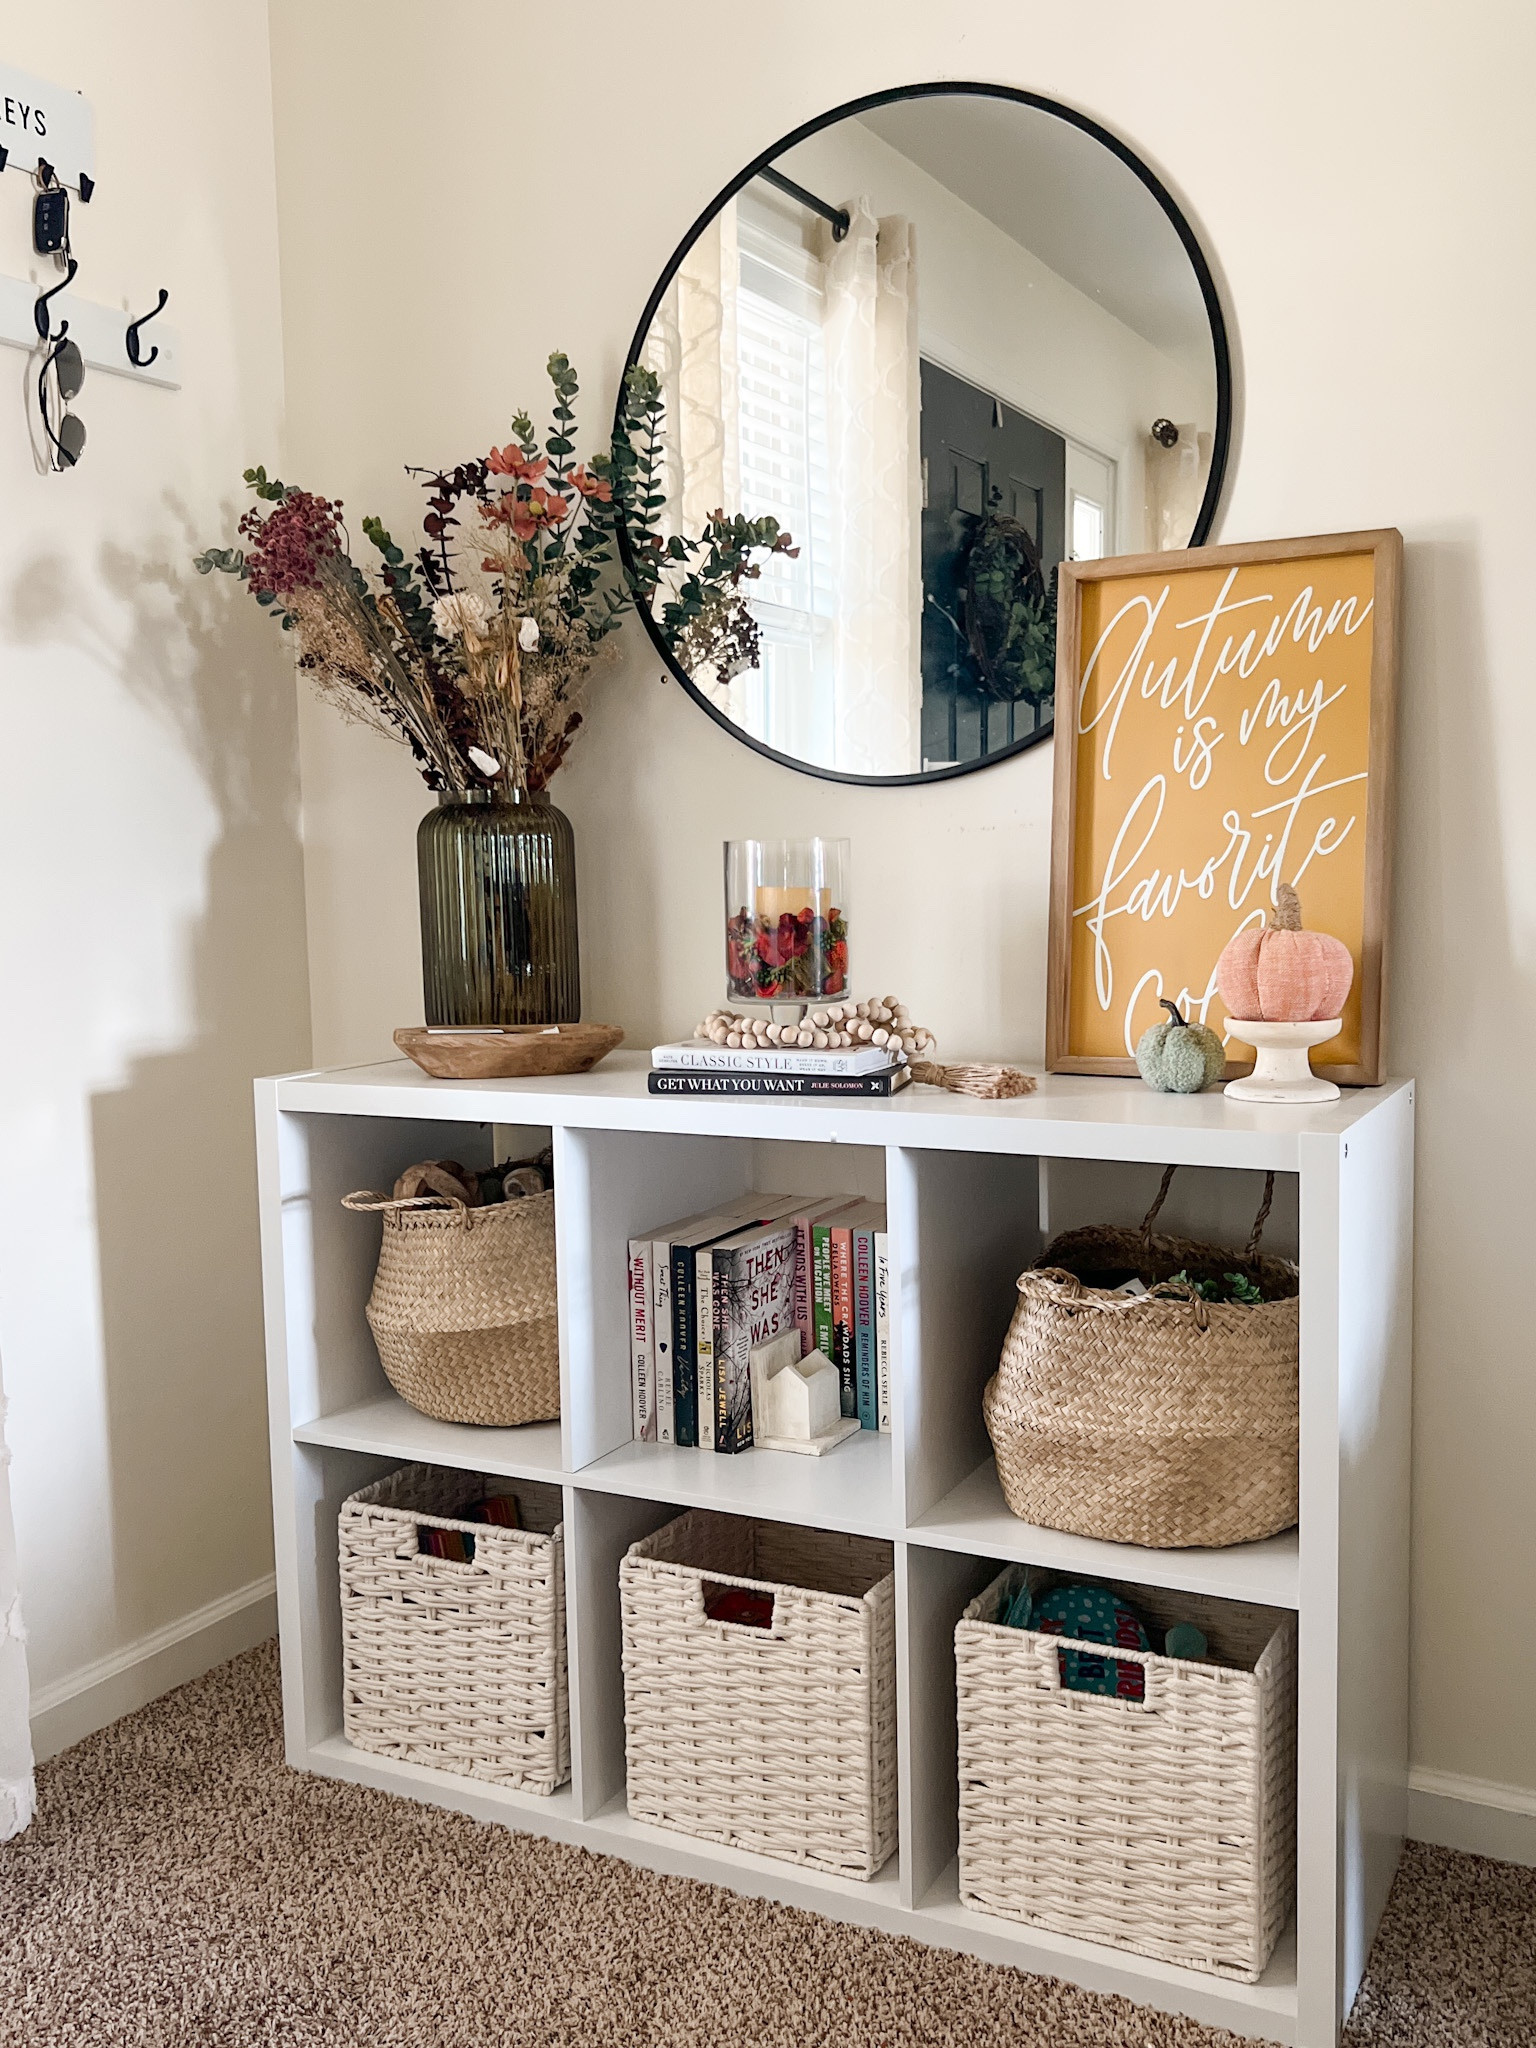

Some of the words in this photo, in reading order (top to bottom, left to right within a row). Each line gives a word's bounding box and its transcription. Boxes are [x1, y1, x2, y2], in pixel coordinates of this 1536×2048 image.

[0, 96, 47, 137] EYS
[1078, 566, 1375, 780] Autumn
[1172, 716, 1225, 791] is
[1239, 678, 1348, 786] my
[1073, 753, 1369, 1012] favorite
[680, 1054, 742, 1068] CLASSIC
[745, 1056, 793, 1070] STYLE
[657, 1077, 686, 1091] GET
[685, 1078, 730, 1092] WHAT
[731, 1079, 763, 1092] YOU
[762, 1079, 805, 1092] WANT
[830, 1082, 864, 1090] SOLOMON
[797, 1228, 805, 1240] IT
[746, 1244, 785, 1285] THEN
[796, 1243, 806, 1272] ENDS
[814, 1246, 821, 1257] ON
[821, 1236, 831, 1270] PEOPLE
[840, 1241, 848, 1279] WHERE
[857, 1237, 869, 1283] COLLEEN
[634, 1258, 645, 1306] WITHOUT
[712, 1271, 720, 1296] WAS
[720, 1273, 729, 1306] THEN
[750, 1273, 781, 1311] SHE
[796, 1274, 808, 1304] WITH
[814, 1259, 824, 1304] VACATION
[822, 1271, 832, 1288] WE
[878, 1266, 890, 1288] Five
[655, 1288, 670, 1308] Thing
[700, 1287, 709, 1304] The
[823, 1288, 833, 1314] MEET
[858, 1285, 870, 1327] HOOVER
[875, 1290, 888, 1319] Years
[635, 1308, 647, 1343] MERIT
[700, 1307, 709, 1335] Choice
[712, 1300, 721, 1332] GONE
[720, 1308, 729, 1331] SHE
[750, 1312, 780, 1345] WAS
[797, 1306, 808, 1321] US
[841, 1306, 850, 1365] CRAWDADS
[860, 1332, 870, 1378] REMINDERS
[880, 1339, 888, 1379] REBECCA
[637, 1354, 646, 1388] COLLEEN
[718, 1360, 727, 1384] LISA
[843, 1367, 851, 1393] SING
[861, 1379, 870, 1390] OF
[638, 1389, 647, 1420] HOOVER
[718, 1387, 727, 1429] JEWELL
[861, 1391, 870, 1407] HIM
[881, 1380, 889, 1406] SERLE
[1077, 1625, 1105, 1679] BET
